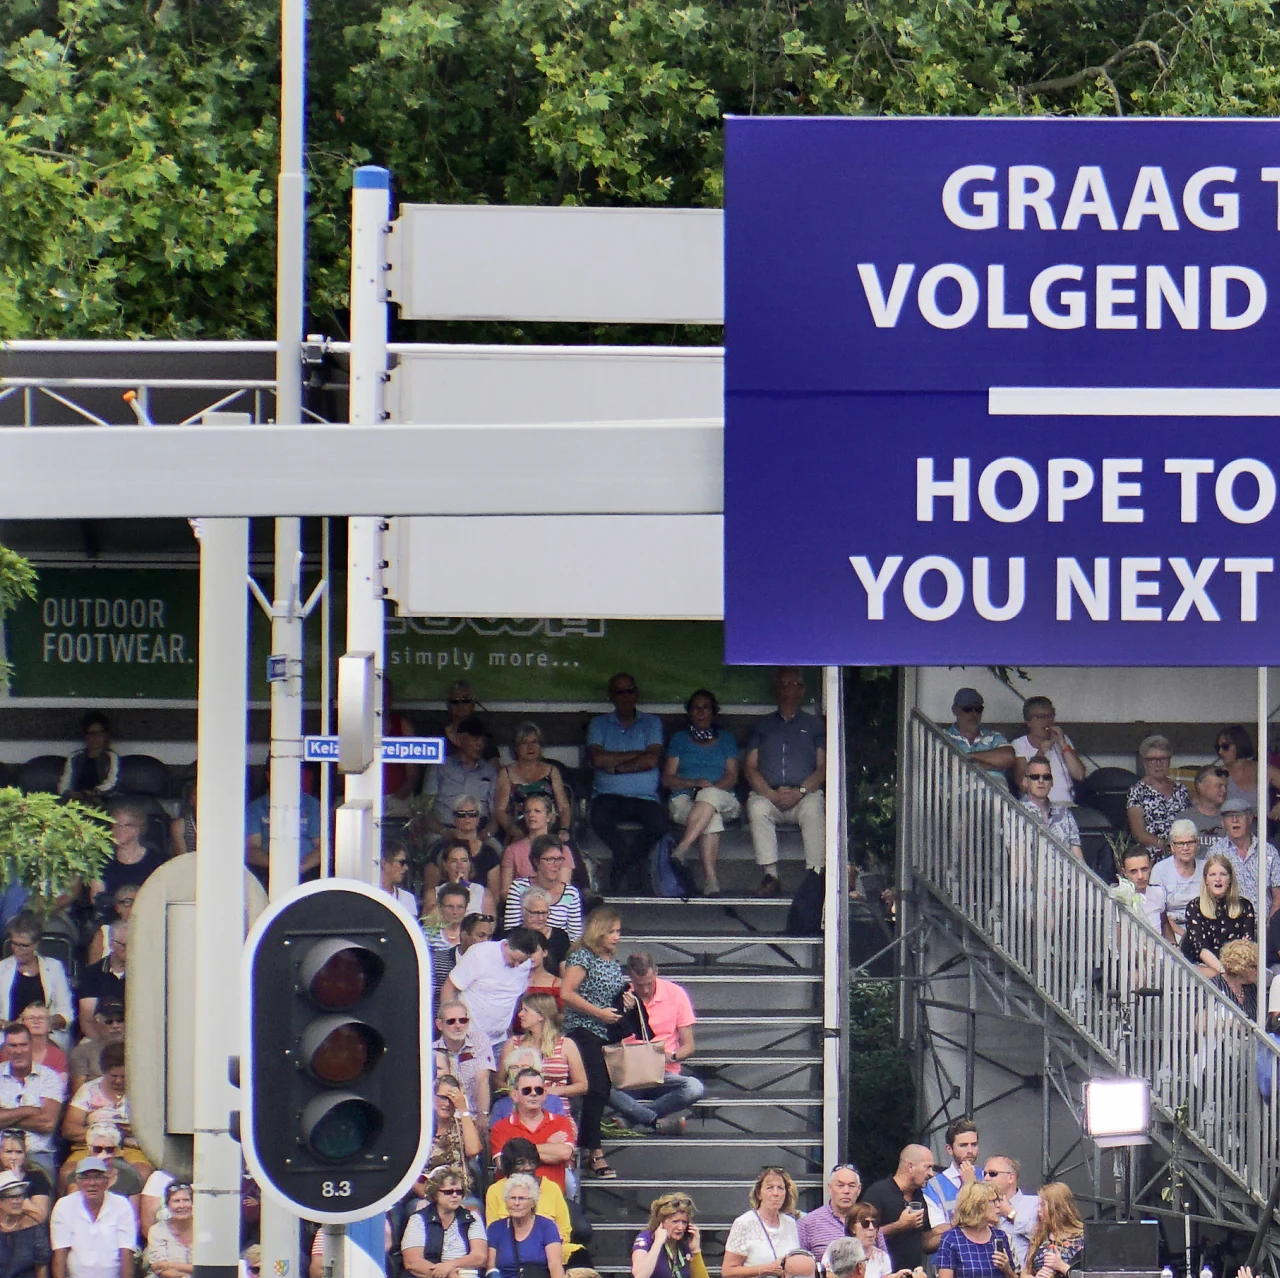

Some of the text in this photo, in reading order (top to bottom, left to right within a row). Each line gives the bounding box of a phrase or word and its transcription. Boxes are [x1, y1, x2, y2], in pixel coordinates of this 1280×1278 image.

[941, 164, 1240, 232] GRAAG
[857, 263, 1269, 331] VOLGEND
[915, 456, 1145, 524] HOPE
[1165, 457, 1278, 524] TO
[43, 598, 165, 628] OUTDOOR
[849, 555, 1027, 622] YOU
[1056, 557, 1275, 623] NEXT
[43, 633, 194, 664] FOOTWEAR.
[391, 648, 580, 670] simply more...
[320, 1179, 352, 1199] 8.3
